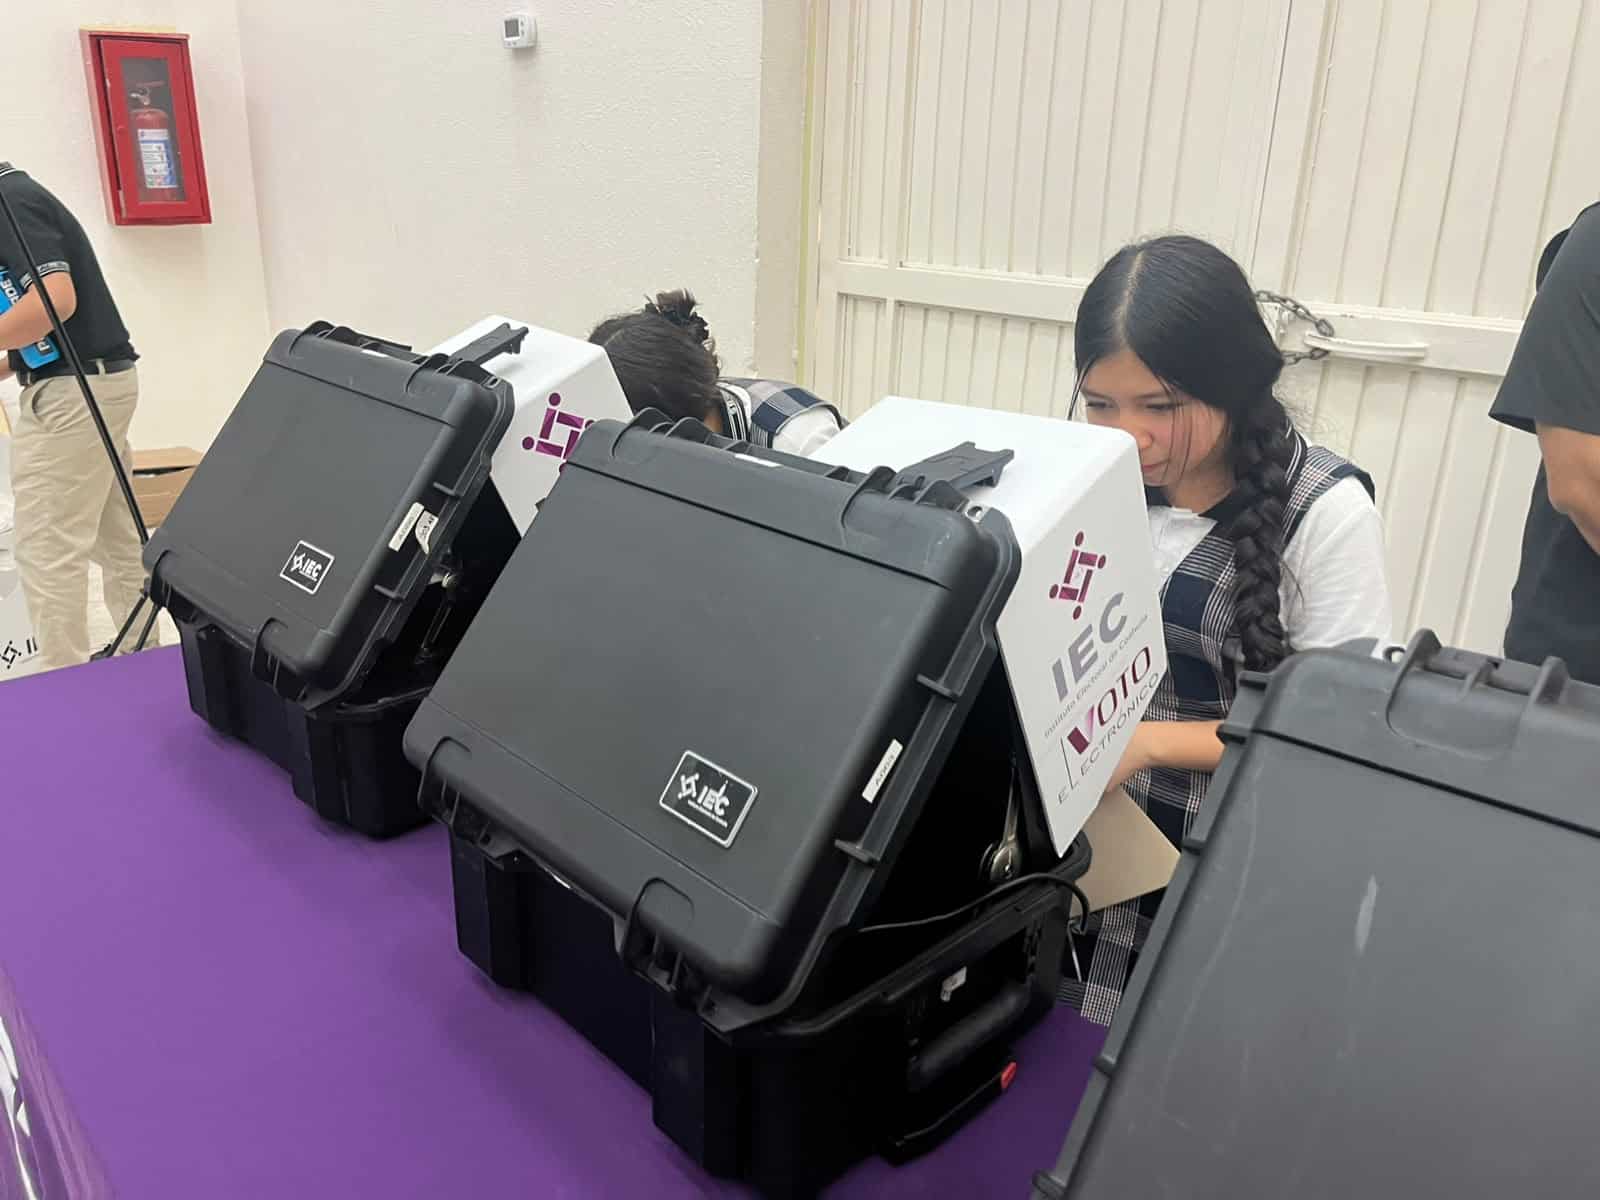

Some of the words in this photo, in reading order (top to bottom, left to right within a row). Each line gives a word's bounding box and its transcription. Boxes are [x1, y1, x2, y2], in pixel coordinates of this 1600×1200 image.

[302, 558, 322, 578] IEC
[1051, 591, 1127, 702] IEC
[1065, 645, 1151, 756] VOTO
[696, 785, 730, 816] IEC
